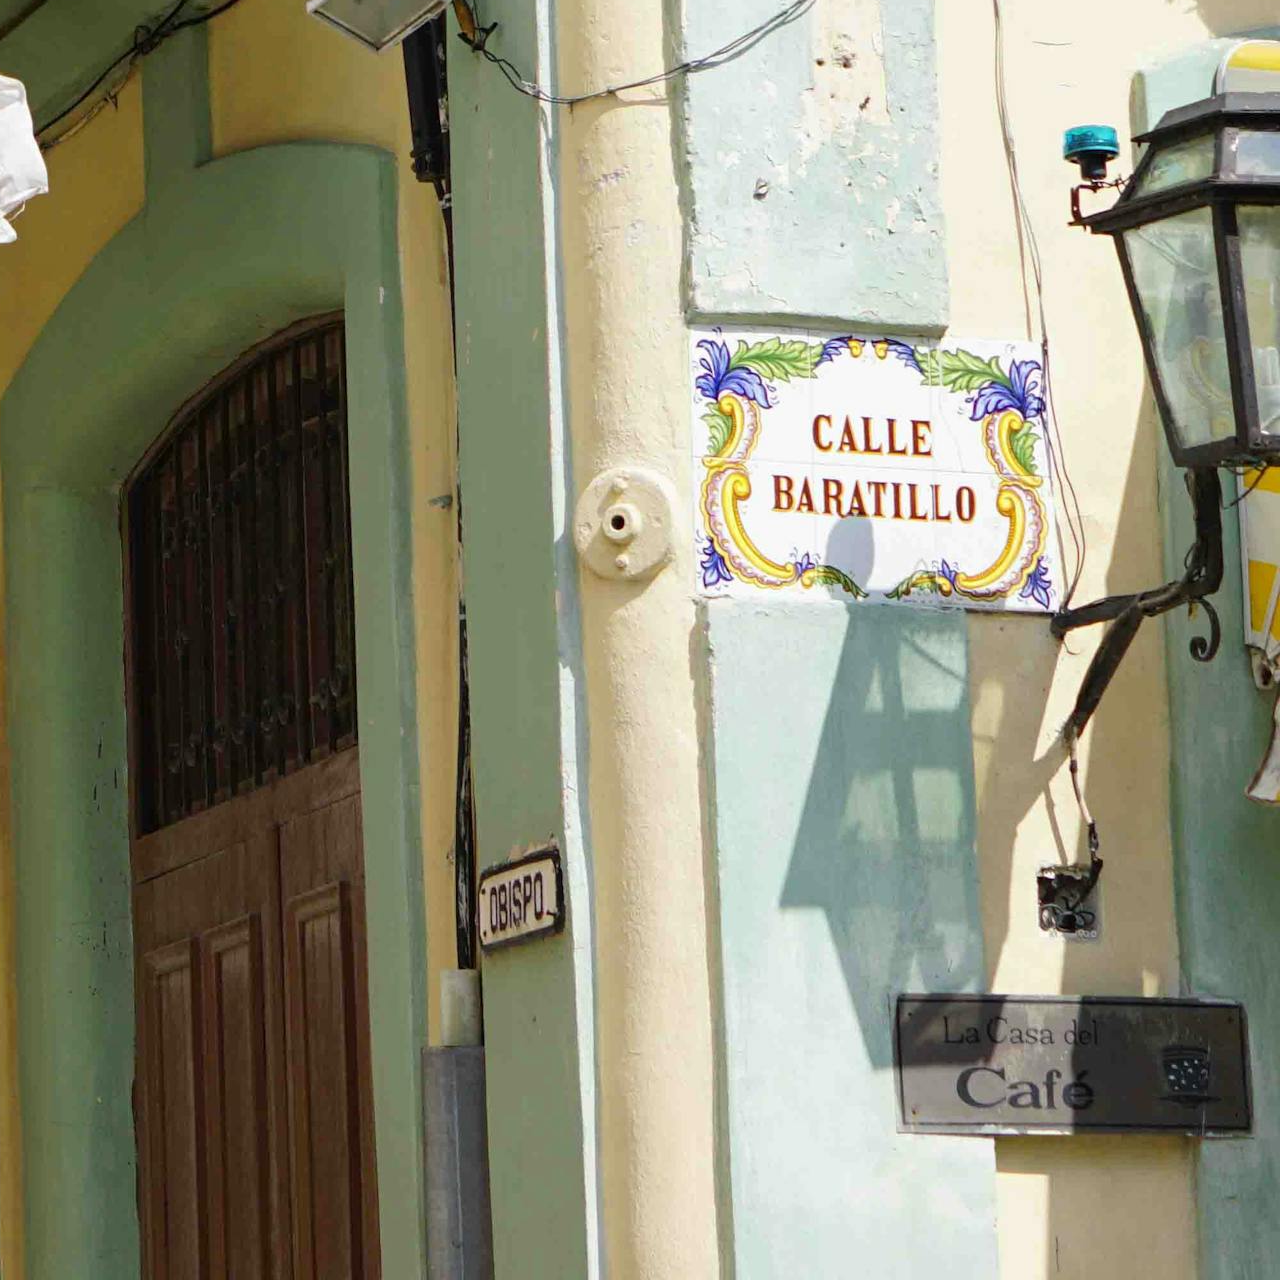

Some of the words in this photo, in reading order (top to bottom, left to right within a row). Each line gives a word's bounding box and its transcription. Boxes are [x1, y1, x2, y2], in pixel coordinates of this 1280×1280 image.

[812, 414, 933, 457] CALLE
[772, 475, 977, 524] BARATILLO
[489, 871, 544, 934] OBISPO
[943, 1016, 981, 1045] La
[986, 1016, 1056, 1045] Casa
[1064, 1019, 1098, 1046] del
[956, 1066, 1095, 1111] Café
